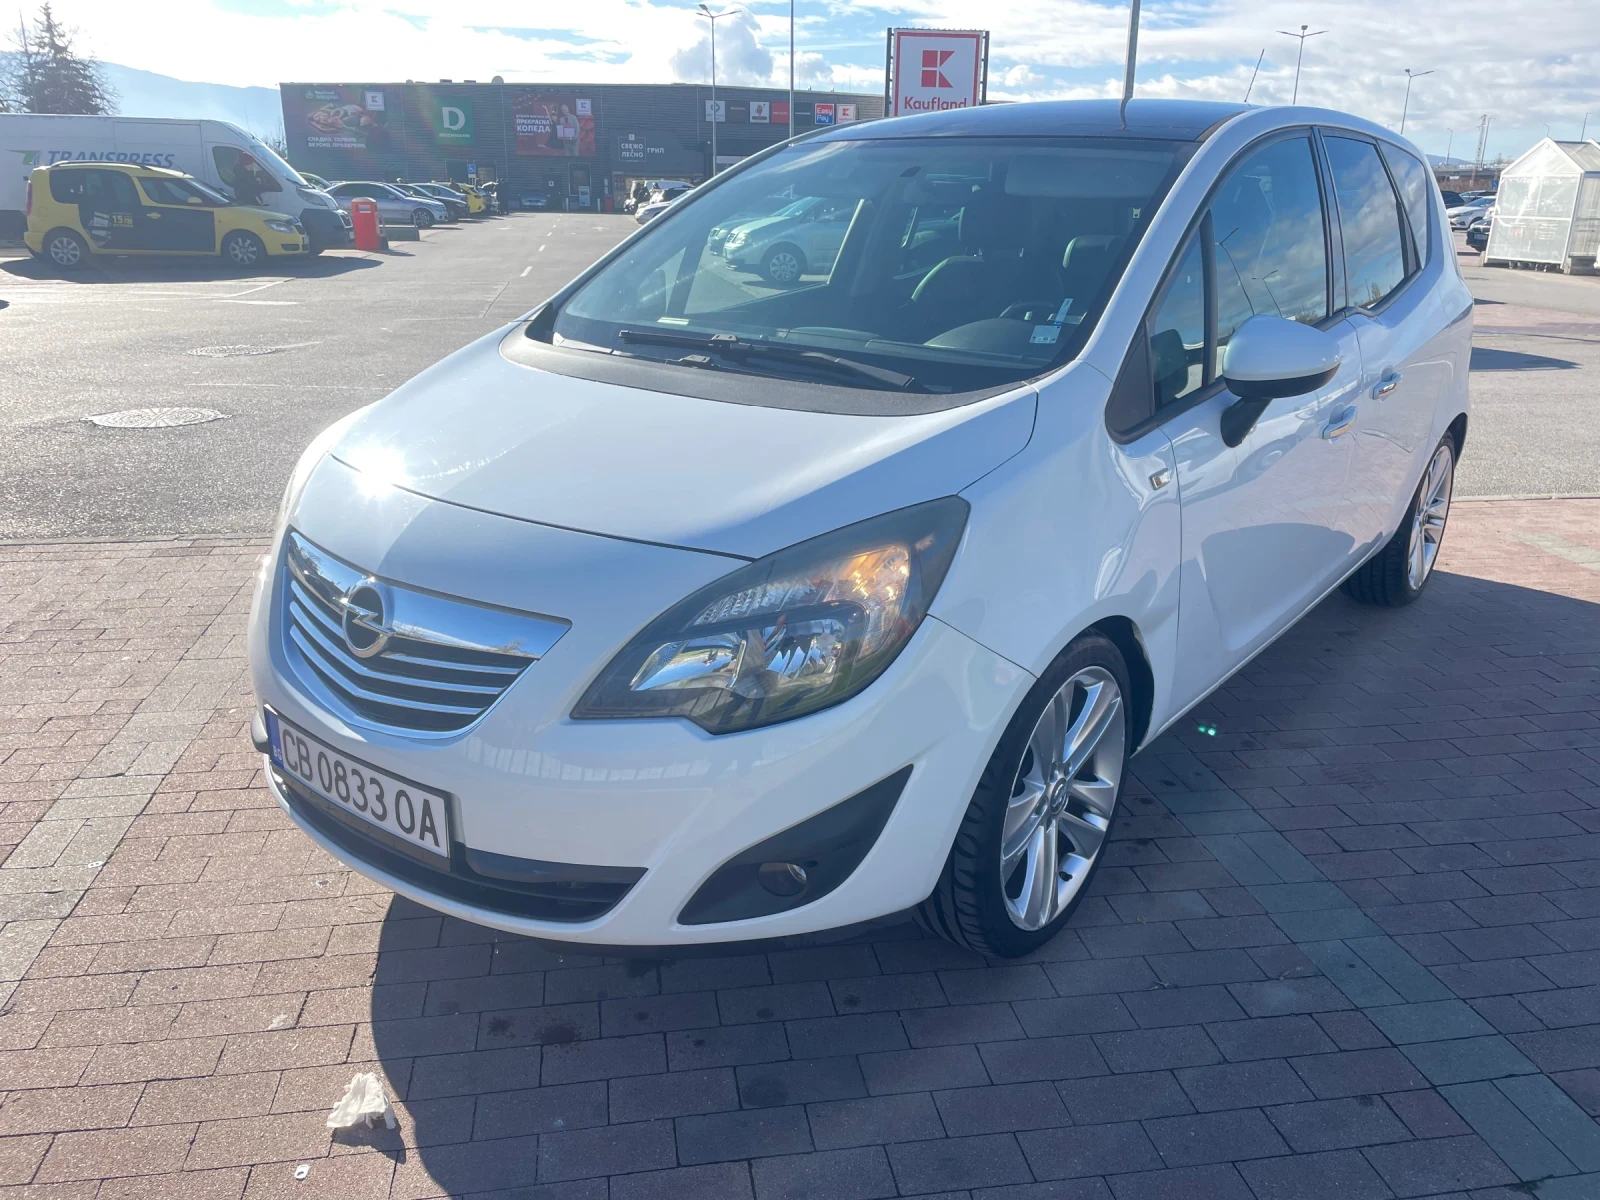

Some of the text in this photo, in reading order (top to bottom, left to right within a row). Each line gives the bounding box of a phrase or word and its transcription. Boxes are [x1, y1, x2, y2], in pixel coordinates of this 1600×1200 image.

[904, 96, 967, 110] Kaufland
[442, 106, 466, 130] D
[816, 107, 833, 115] Easy
[816, 114, 829, 123] Pay
[516, 125, 551, 133] КОЛЕДА
[48, 151, 175, 168] TRANSPRESS
[273, 746, 283, 761] BG
[282, 728, 440, 848] CB 0833 OA
